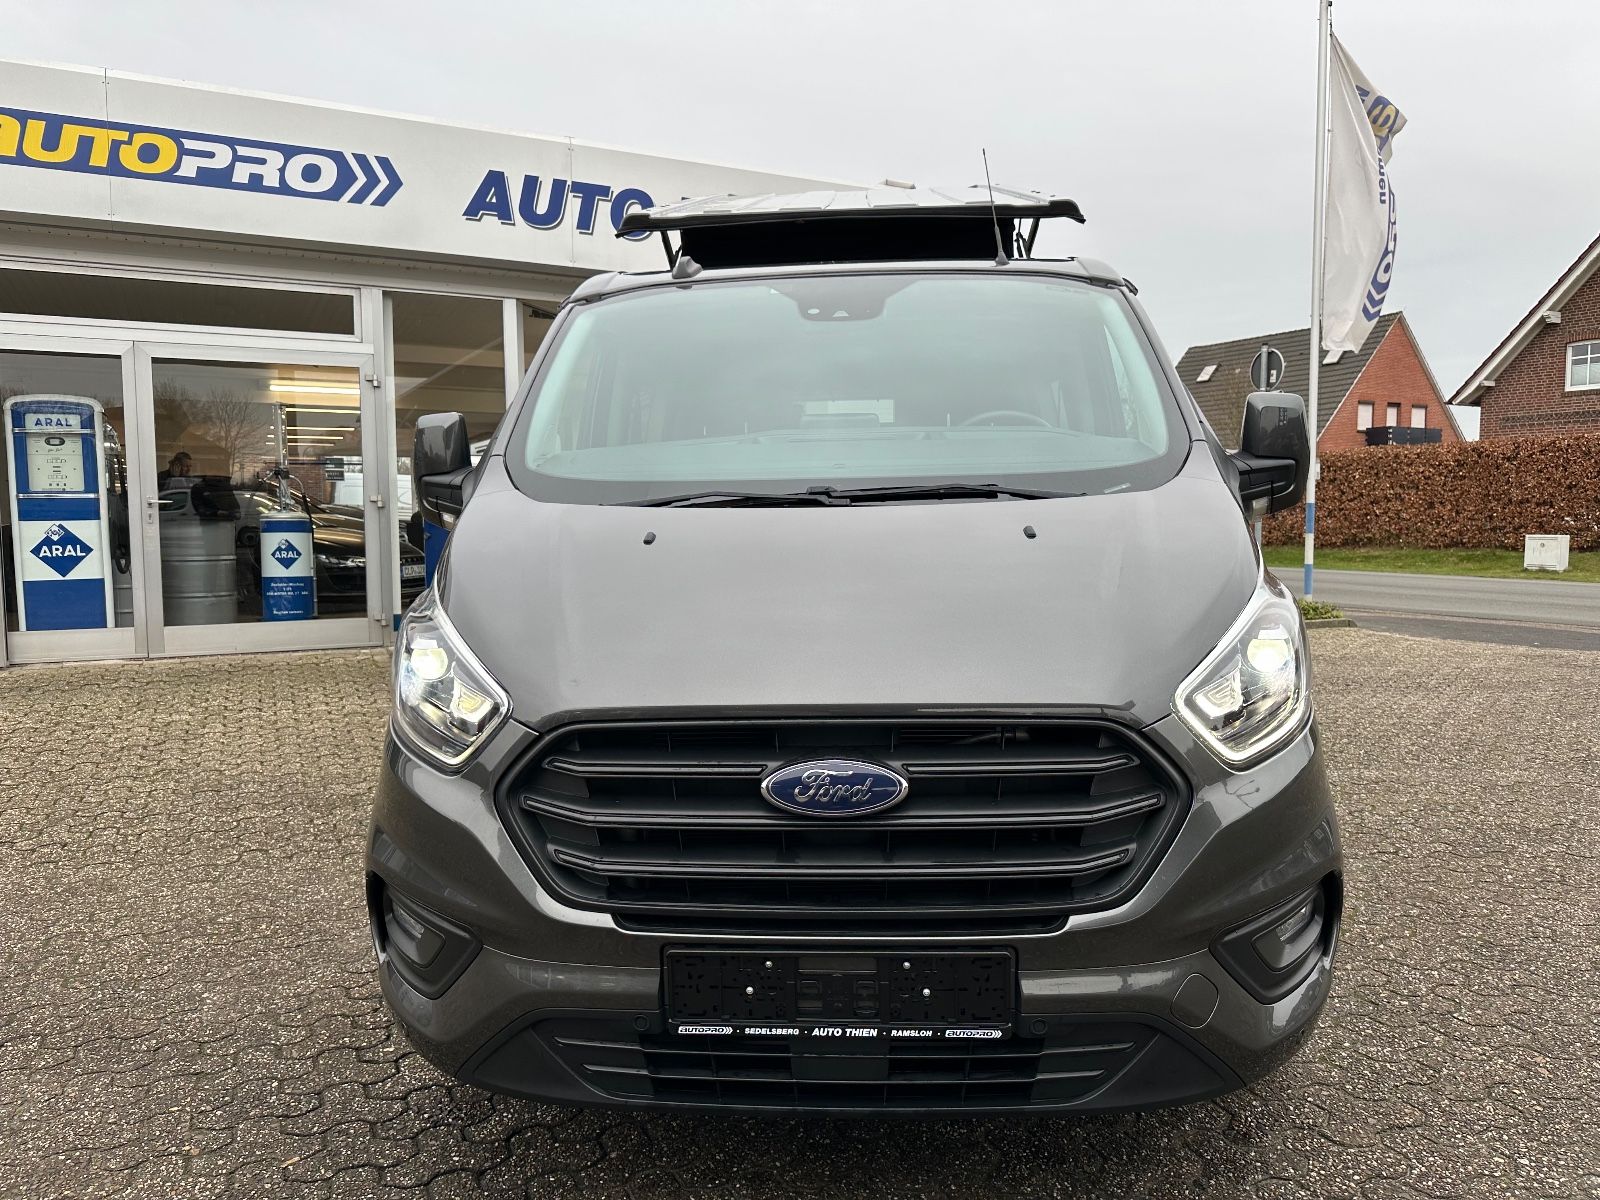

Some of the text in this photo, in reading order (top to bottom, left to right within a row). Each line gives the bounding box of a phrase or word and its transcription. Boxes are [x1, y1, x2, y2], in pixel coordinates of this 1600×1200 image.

[462, 169, 656, 240] AUTO
[34, 417, 72, 427] ARAL
[38, 544, 86, 557] ARAL
[274, 551, 299, 559] ARAL
[793, 769, 874, 802] Ford
[744, 1027, 800, 1035] SEDELSBERG
[812, 1027, 842, 1037] AUTO
[845, 1028, 878, 1037] THIEN
[890, 1029, 933, 1037] RAMSLOH
